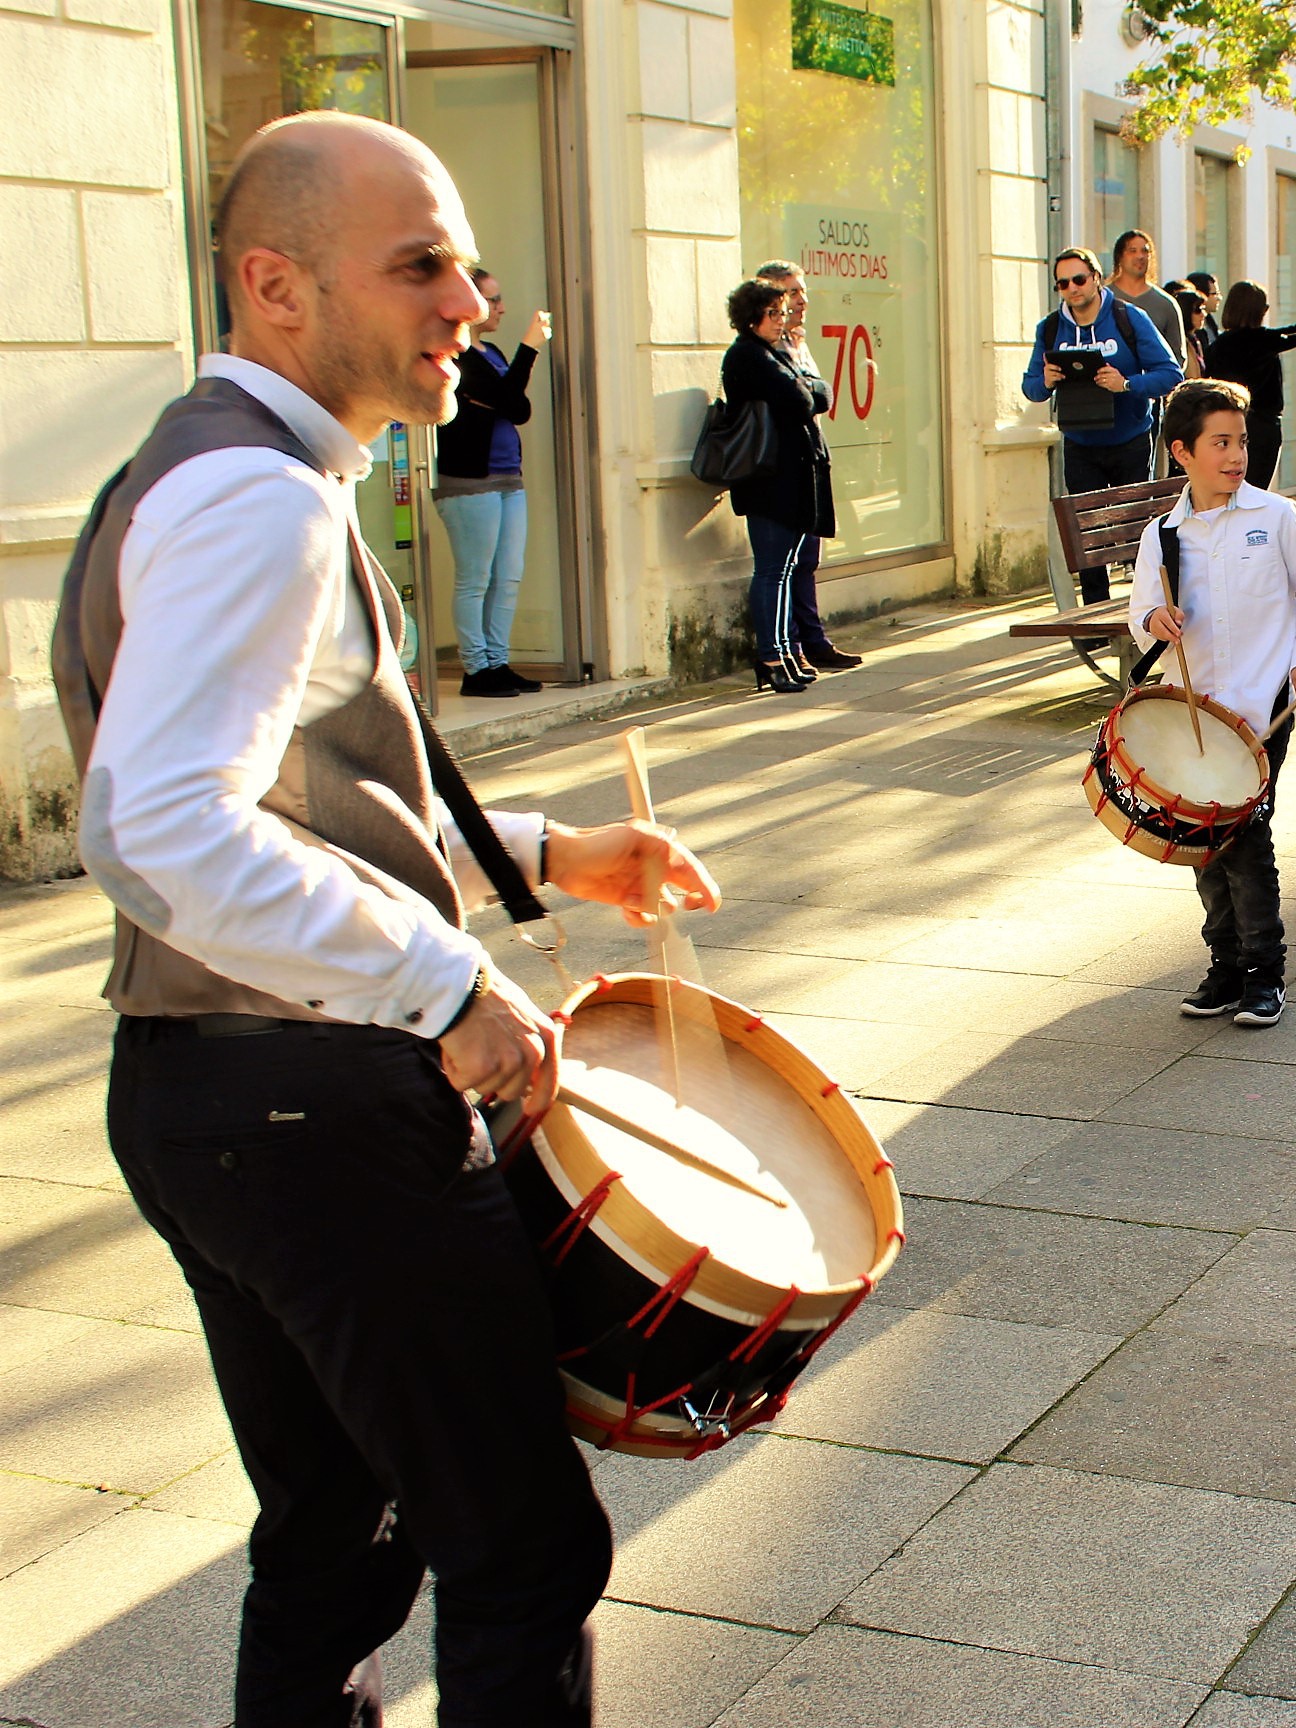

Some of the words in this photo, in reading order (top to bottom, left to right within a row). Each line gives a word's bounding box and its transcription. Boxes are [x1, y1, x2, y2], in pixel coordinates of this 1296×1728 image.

[829, 33, 873, 57] BENETTON
[819, 219, 869, 248] SALDOS
[801, 243, 857, 277] ÚLTIMOS
[860, 253, 888, 279] DIAS
